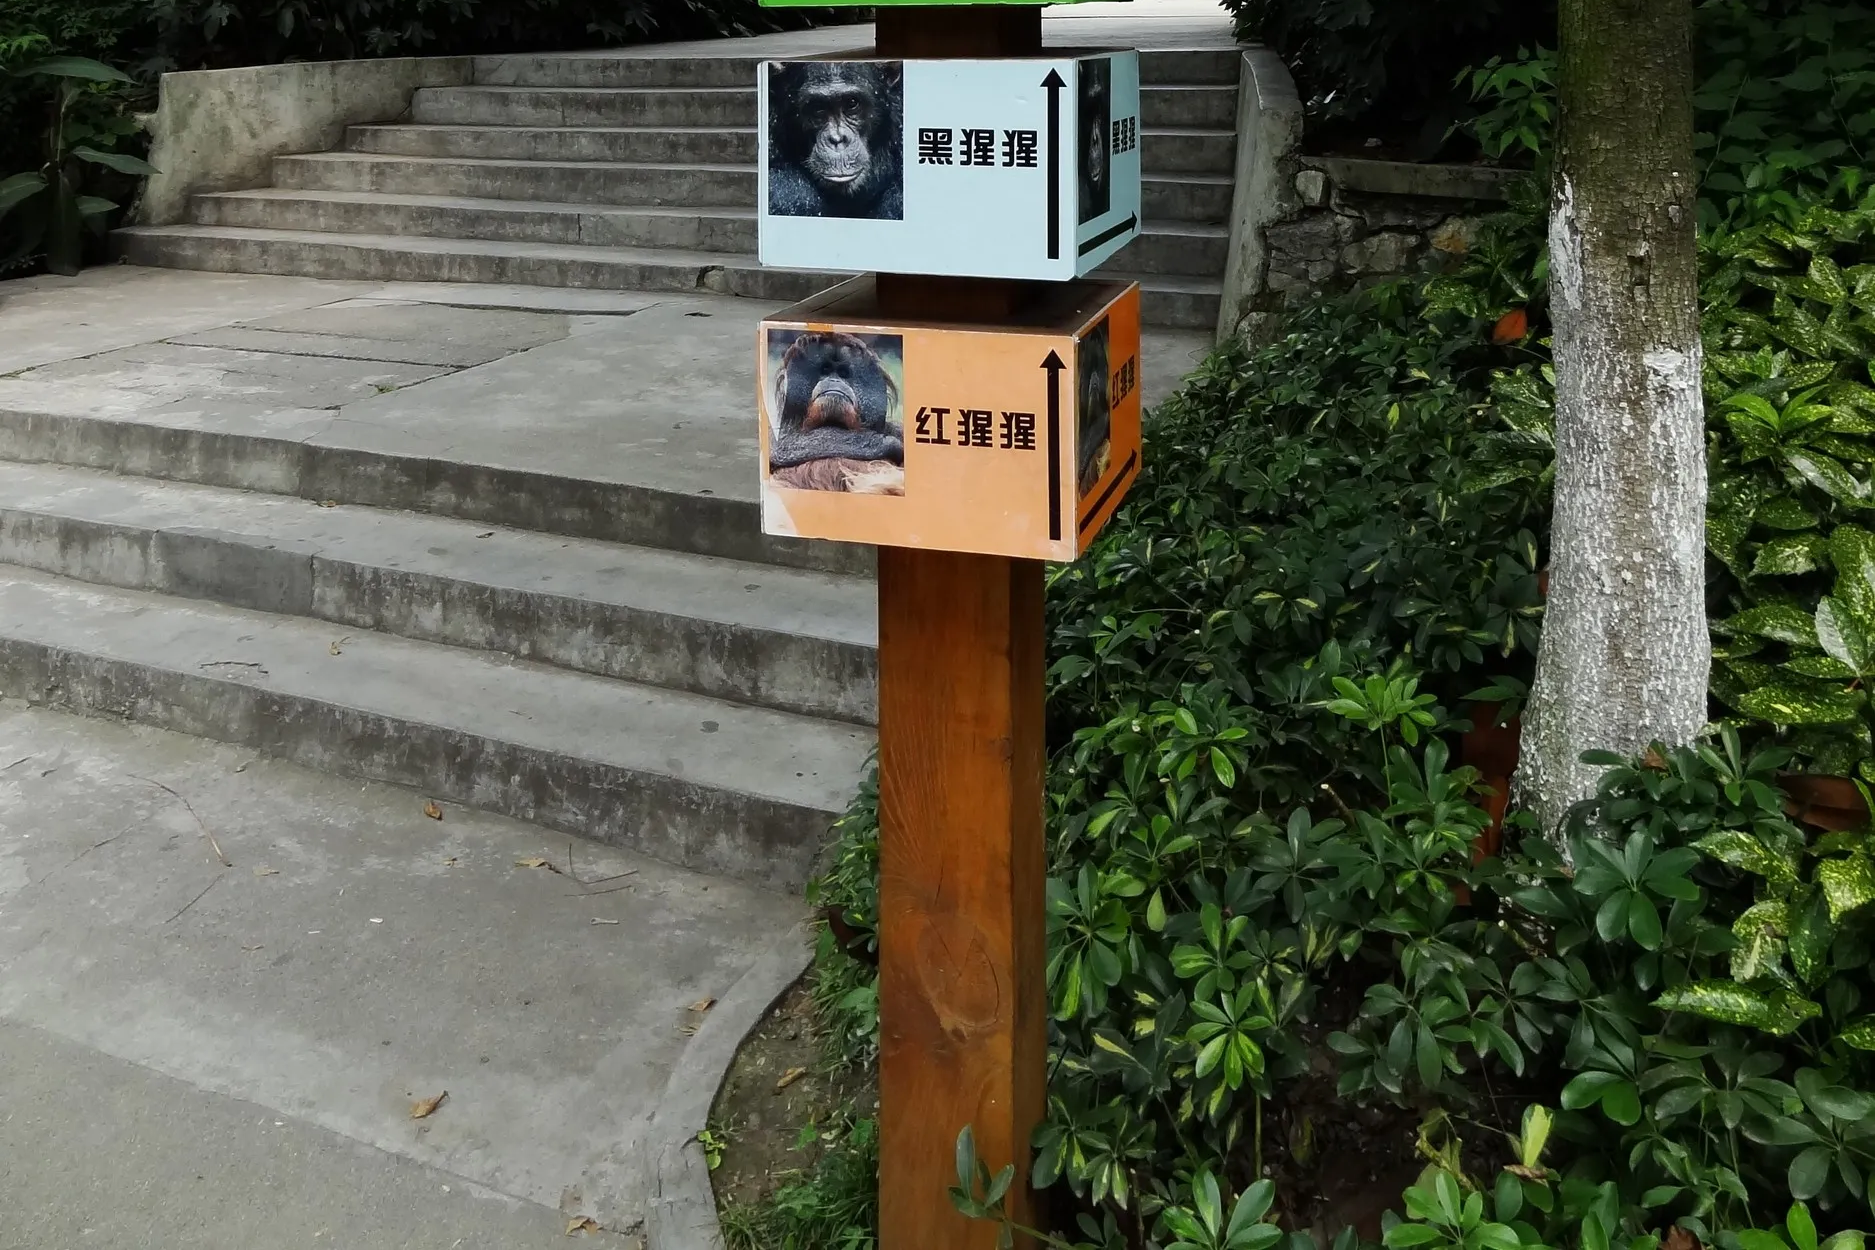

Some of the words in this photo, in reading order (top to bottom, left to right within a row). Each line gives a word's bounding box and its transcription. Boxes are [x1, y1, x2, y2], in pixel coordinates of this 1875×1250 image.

[917, 127, 1039, 168] 黑猩猩
[914, 406, 1037, 451] 红猩猩
